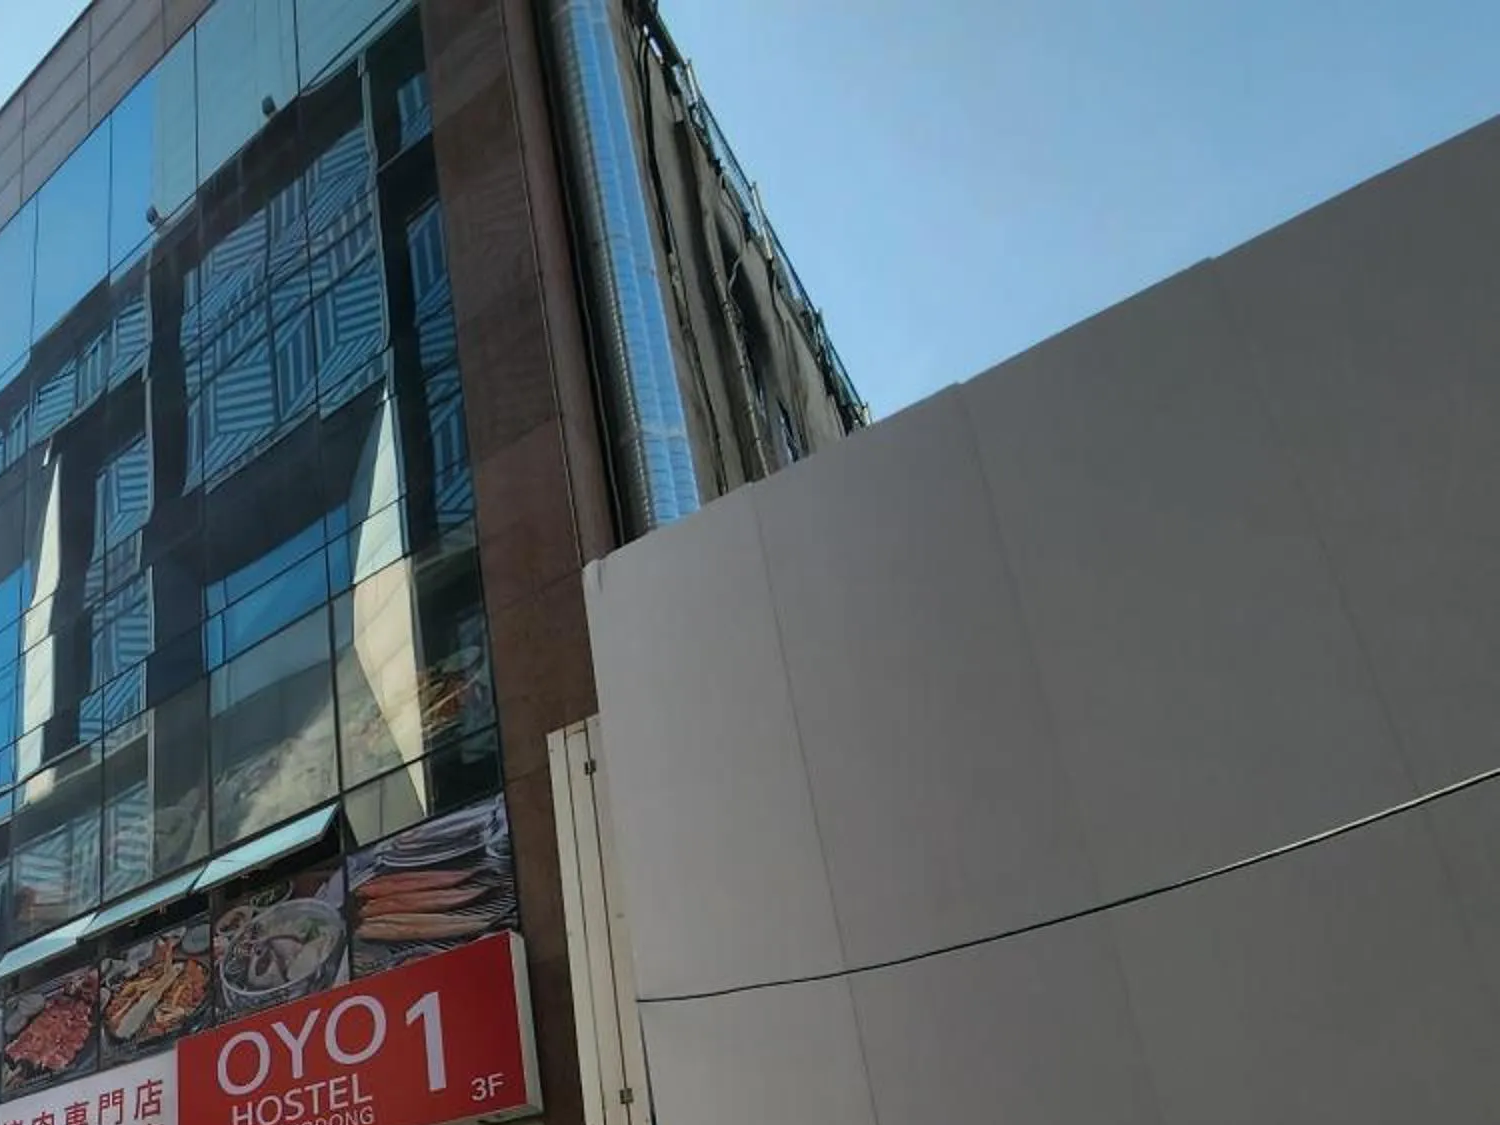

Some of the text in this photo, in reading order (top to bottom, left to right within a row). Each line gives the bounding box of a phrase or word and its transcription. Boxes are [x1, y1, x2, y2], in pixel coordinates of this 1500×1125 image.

[217, 991, 447, 1096] OYO 1
[470, 1072, 505, 1102] 3F
